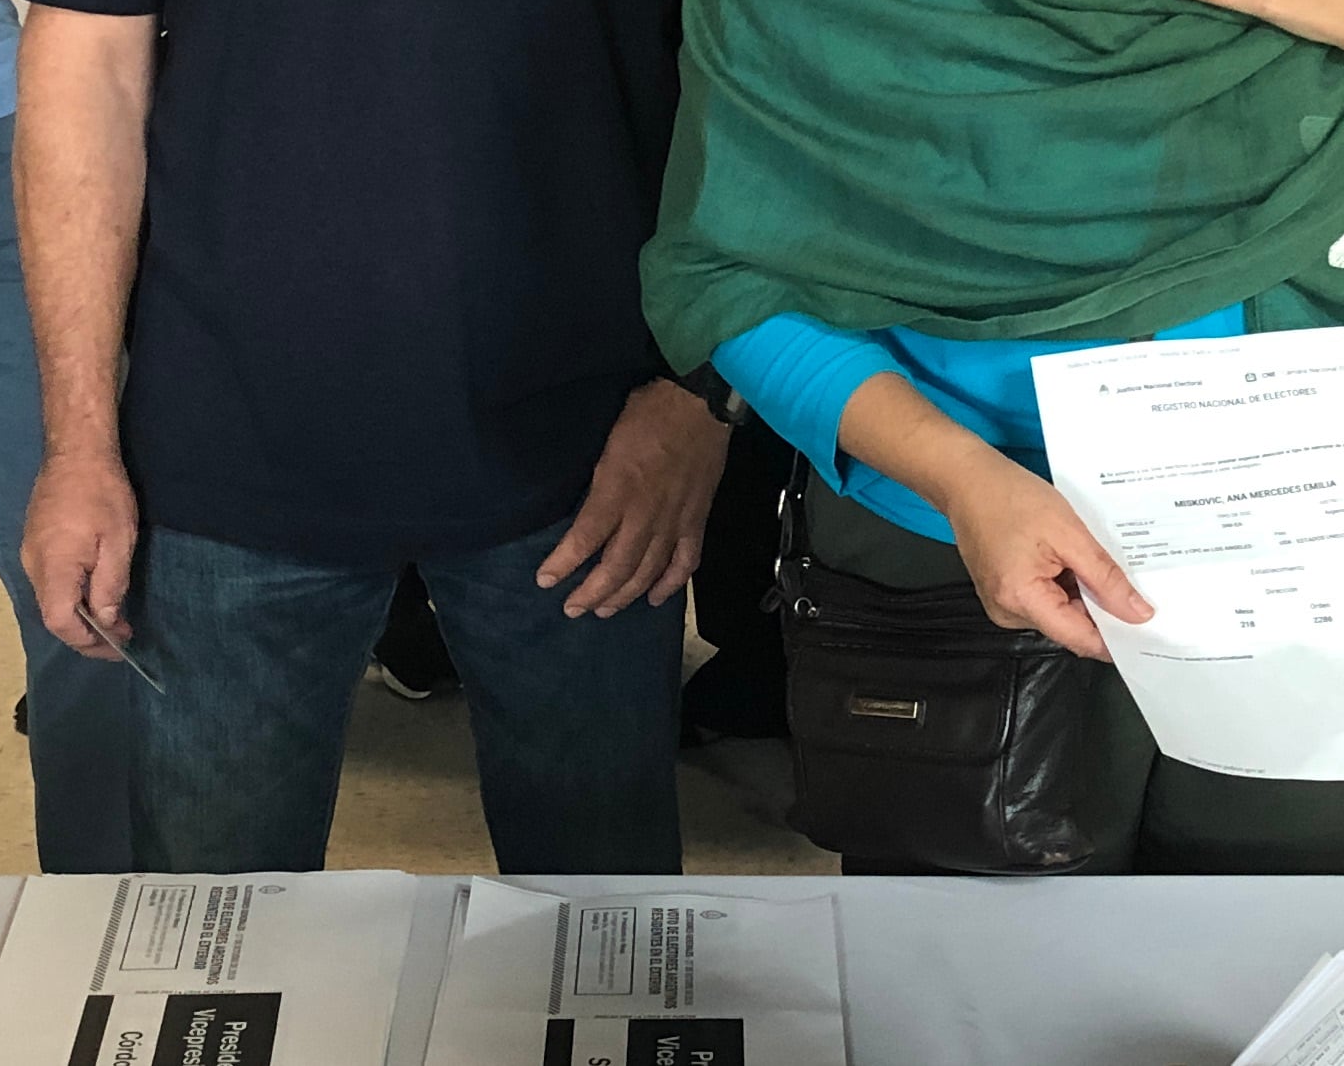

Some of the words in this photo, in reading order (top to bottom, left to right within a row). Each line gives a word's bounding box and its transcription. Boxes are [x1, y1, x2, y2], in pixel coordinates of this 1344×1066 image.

[1151, 402, 1196, 412] REGISTRO
[1199, 398, 1246, 408] NACIONAL
[1249, 394, 1260, 402] DE
[1263, 388, 1318, 400] ELECTORES
[1227, 494, 1247, 502] ANA
[1250, 486, 1302, 498] MERCEDES
[1304, 480, 1336, 491] EMILIA
[667, 908, 680, 925] VOTO
[667, 926, 679, 935] DE
[182, 1008, 217, 1066] Vicepres
[657, 1036, 680, 1066] Vice
[690, 1052, 714, 1066] Pr
